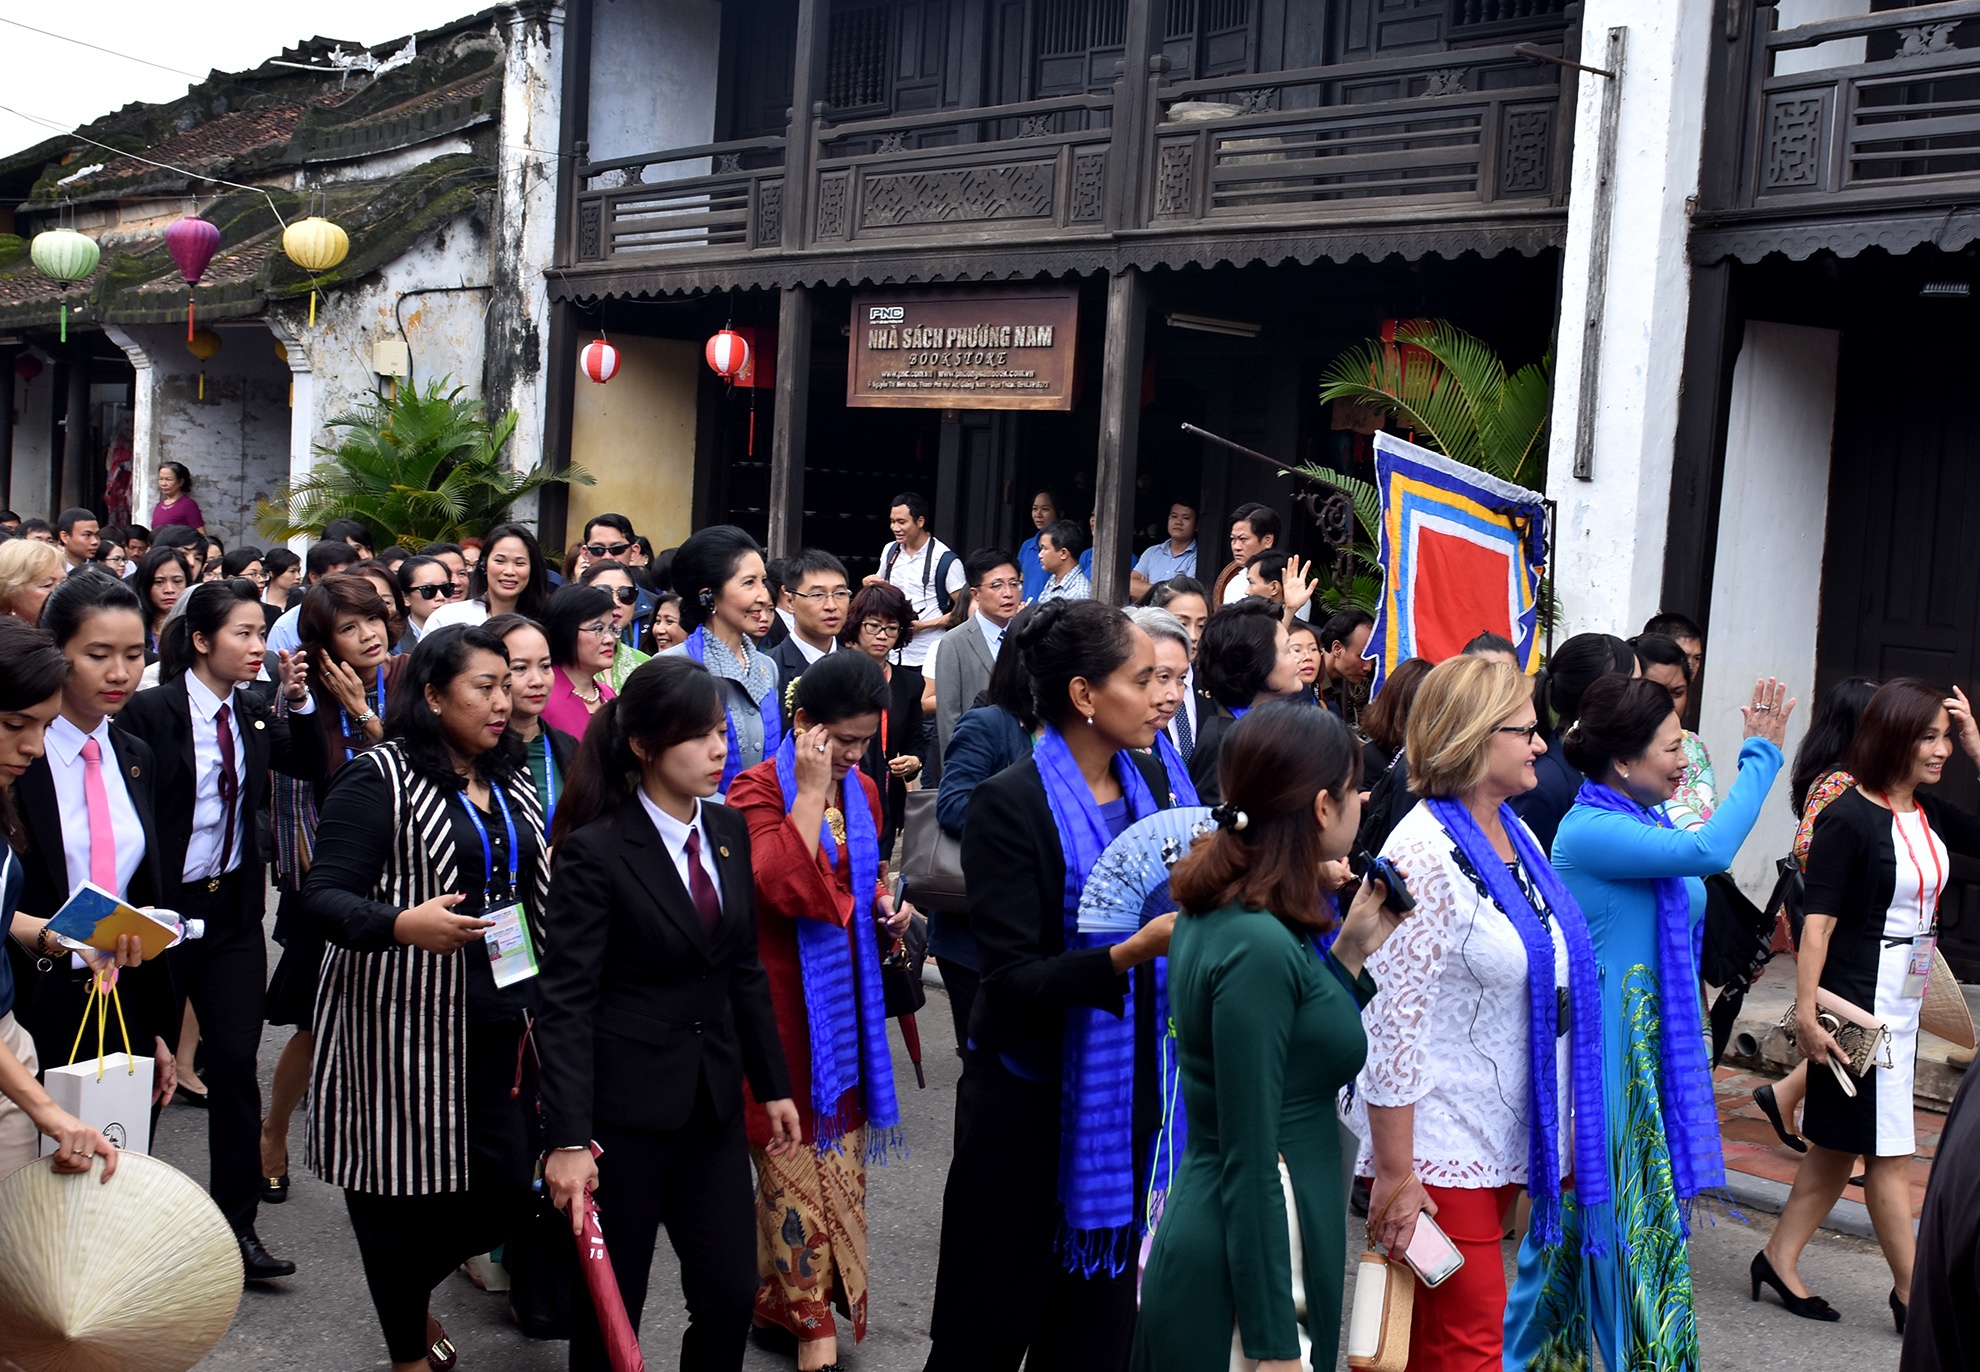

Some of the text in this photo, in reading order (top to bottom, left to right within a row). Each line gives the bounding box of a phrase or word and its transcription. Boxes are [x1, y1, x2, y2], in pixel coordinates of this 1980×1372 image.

[870, 307, 904, 319] PNC
[868, 323, 1053, 349] NHÀ SÁCH PHƯƠNG NAM
[909, 352, 1008, 367] BOOKSTORE
